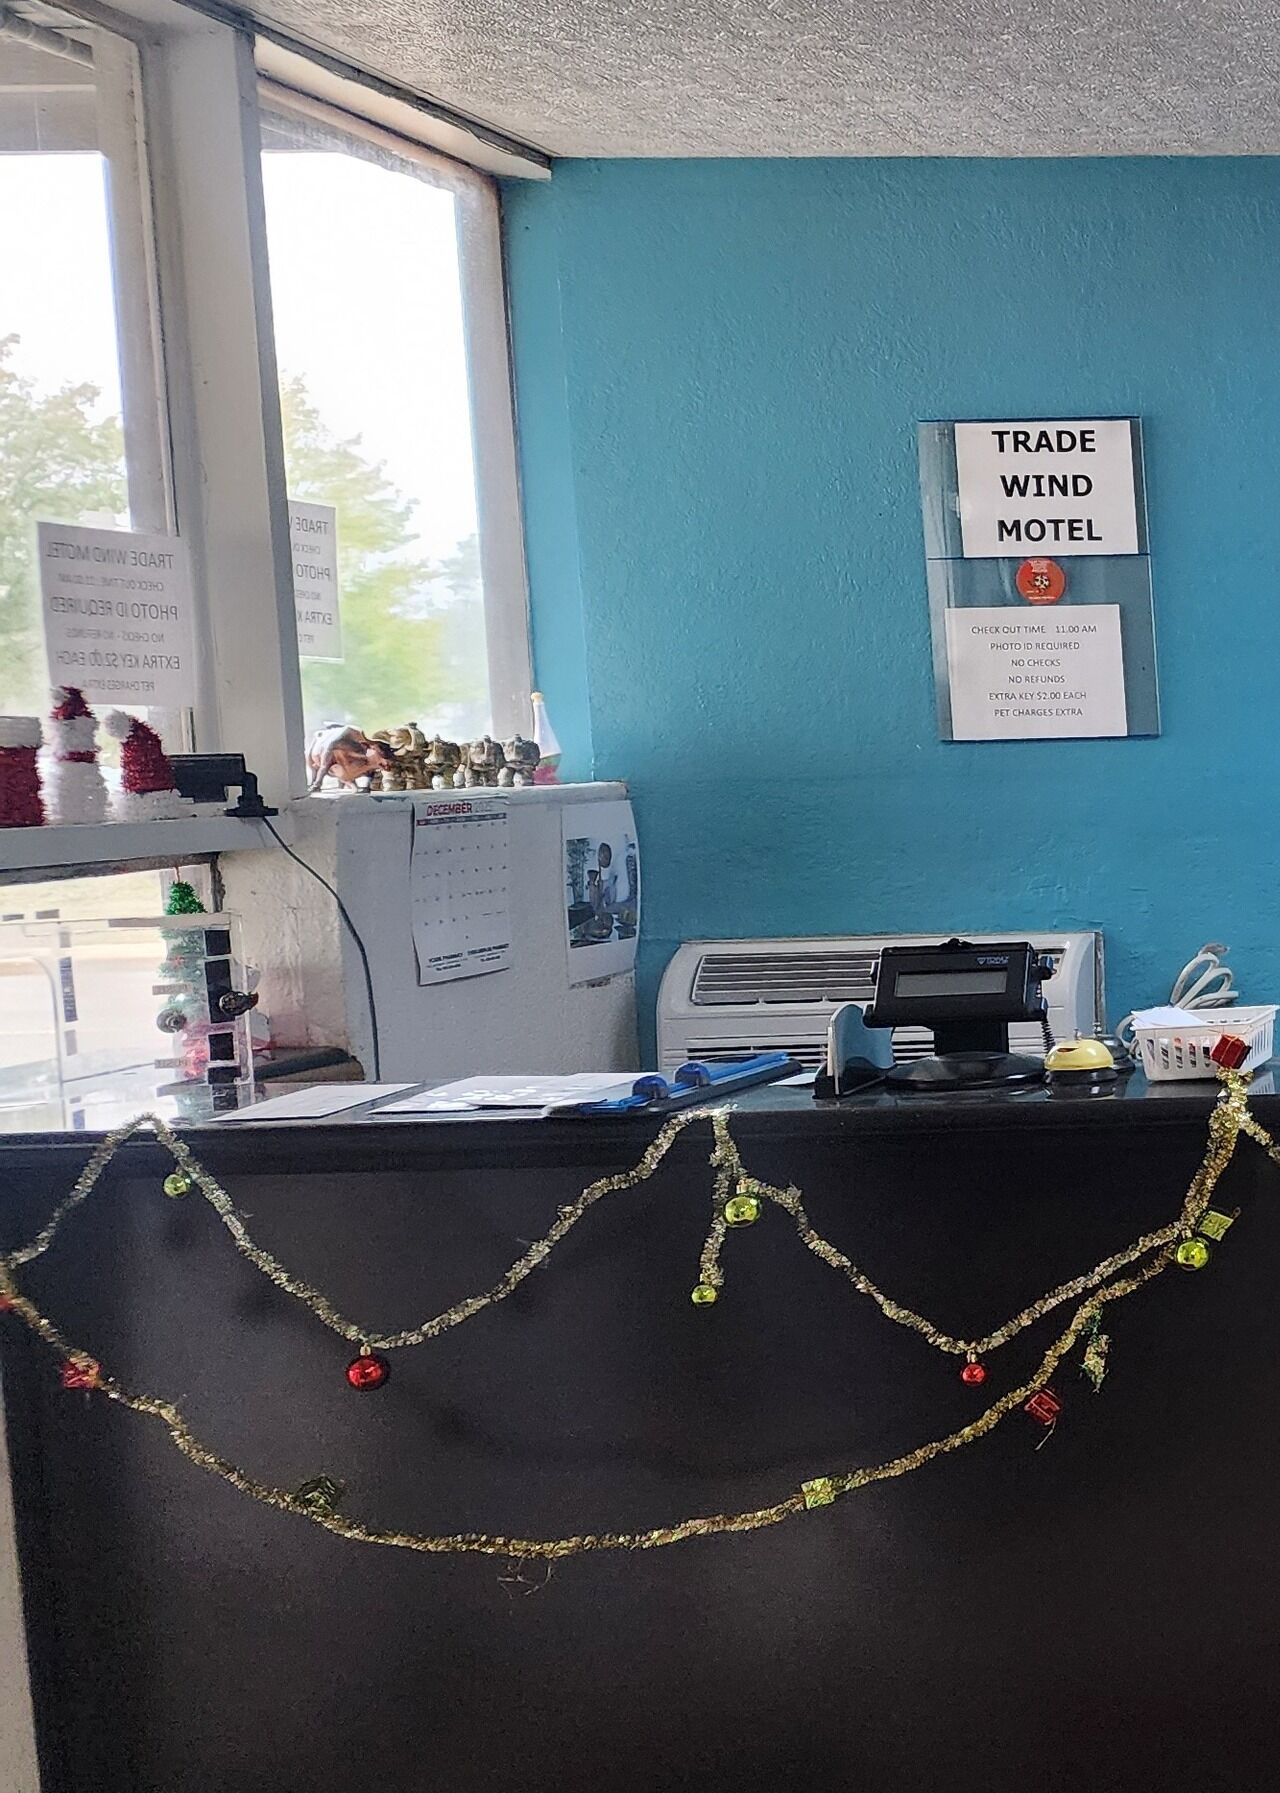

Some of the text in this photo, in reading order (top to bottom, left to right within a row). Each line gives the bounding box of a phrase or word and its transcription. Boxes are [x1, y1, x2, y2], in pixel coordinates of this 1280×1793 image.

[992, 430, 1095, 452] TRADE
[1000, 475, 1092, 497] WIND
[998, 519, 1102, 541] MOTEL
[971, 626, 999, 634] CHECK
[1002, 626, 1021, 634] OUT
[1035, 642, 1080, 650] REQUIRED
[1019, 692, 1034, 700] KEY
[1037, 692, 1061, 700] $2.00
[994, 709, 1009, 717] PET
[1056, 708, 1083, 716] EXTRA
[426, 802, 473, 817] DECEMBER
